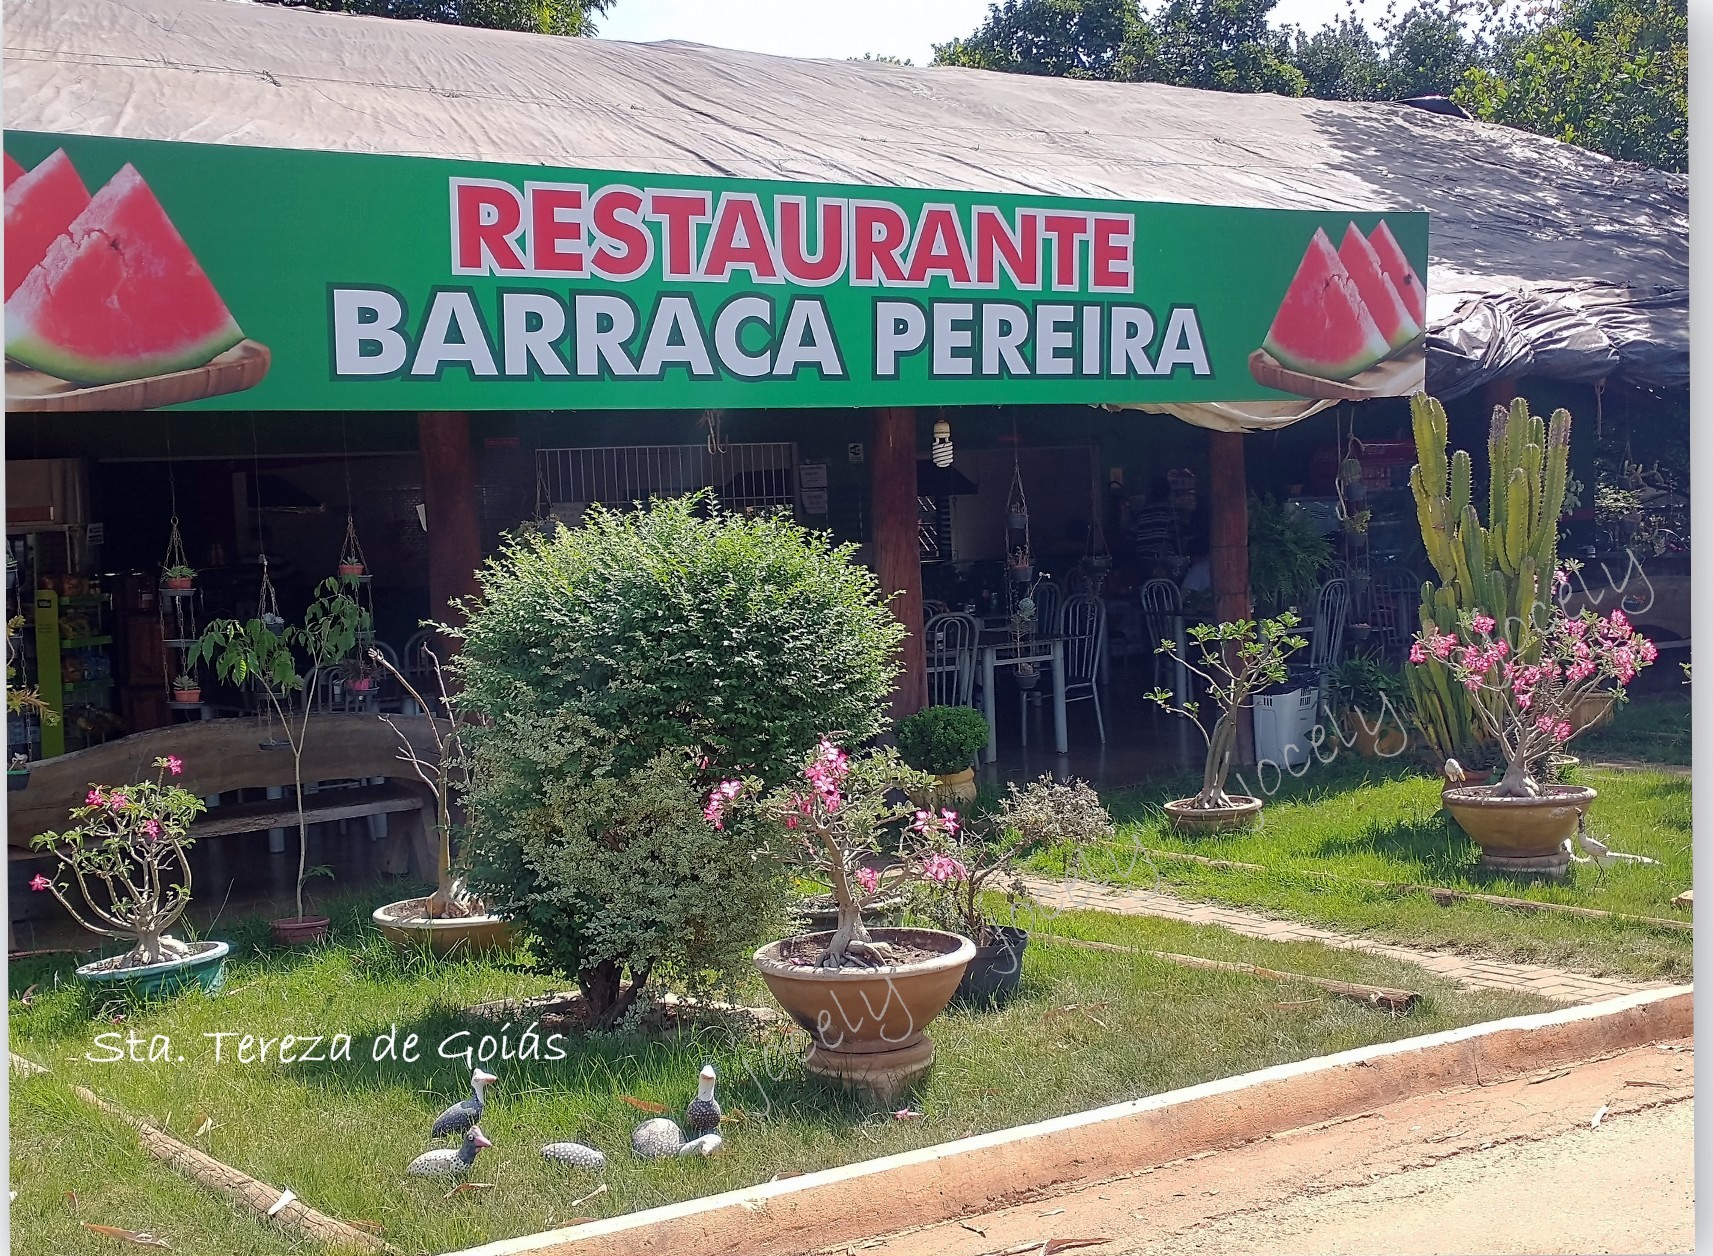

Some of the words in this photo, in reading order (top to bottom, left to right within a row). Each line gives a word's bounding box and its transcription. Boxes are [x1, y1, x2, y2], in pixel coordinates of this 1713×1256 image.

[449, 176, 1136, 294] RESTAURANTE
[329, 285, 848, 379] BARRACA
[873, 299, 1214, 378] PEREIRA
